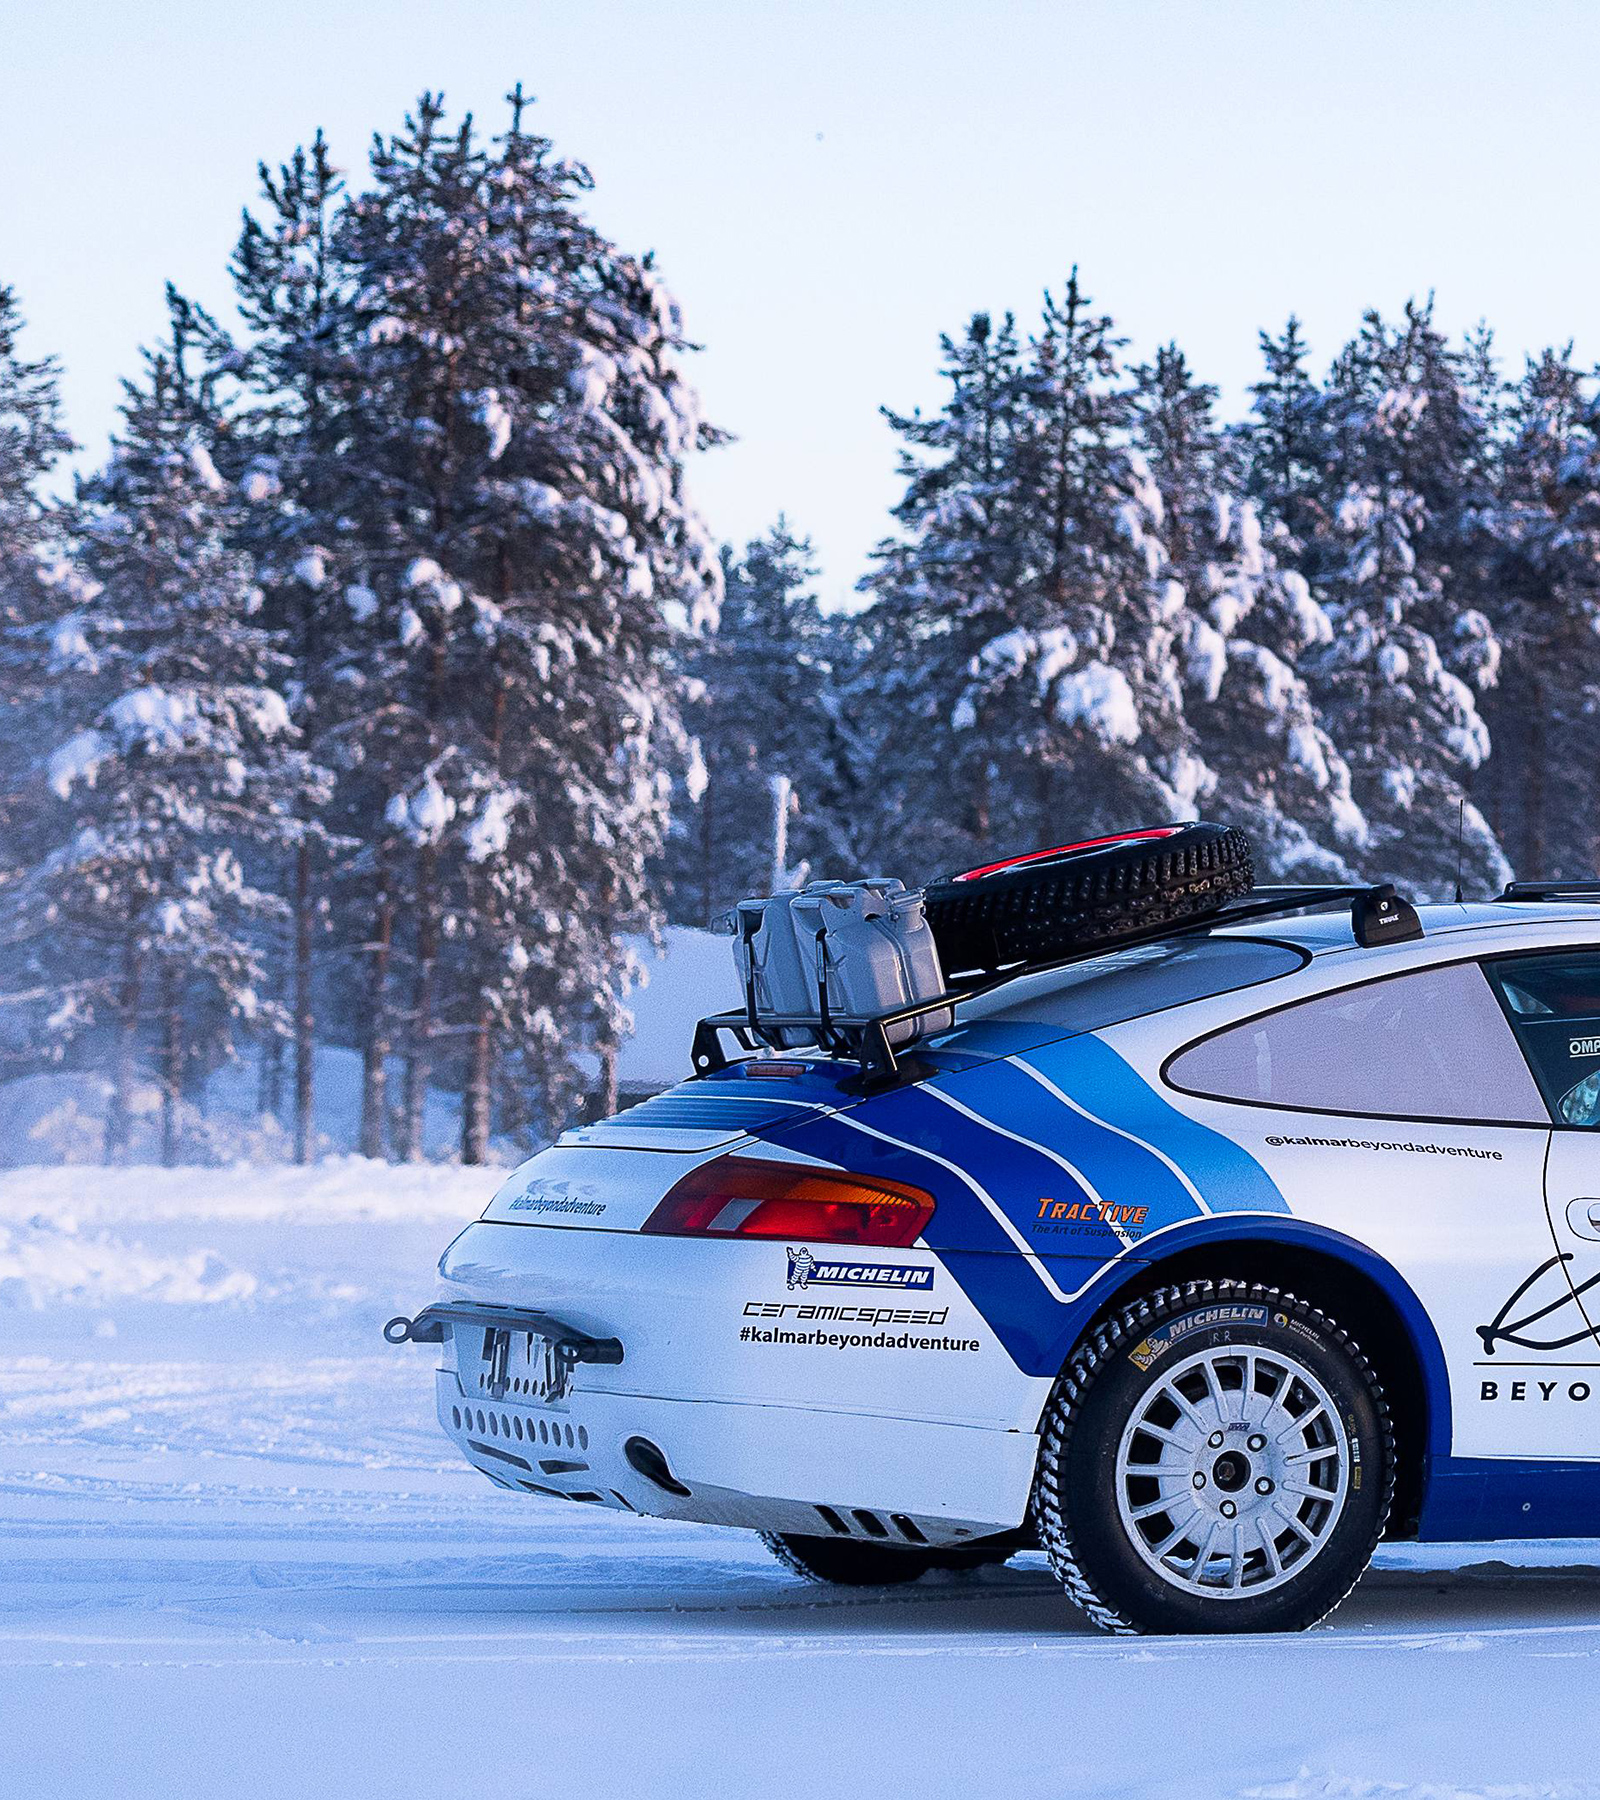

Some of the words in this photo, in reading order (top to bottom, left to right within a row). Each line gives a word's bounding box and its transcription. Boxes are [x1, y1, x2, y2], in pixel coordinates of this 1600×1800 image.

[1264, 1135, 1504, 1161] @kalmarbeyondadventure
[1031, 1224, 1050, 1234] The
[1050, 1224, 1069, 1235] Art
[1083, 1226, 1143, 1239] Suspension
[815, 1265, 931, 1285] MICHELIN
[1169, 1306, 1265, 1338] MICHELIN
[739, 1326, 981, 1352] #kalmarbeyondadventure
